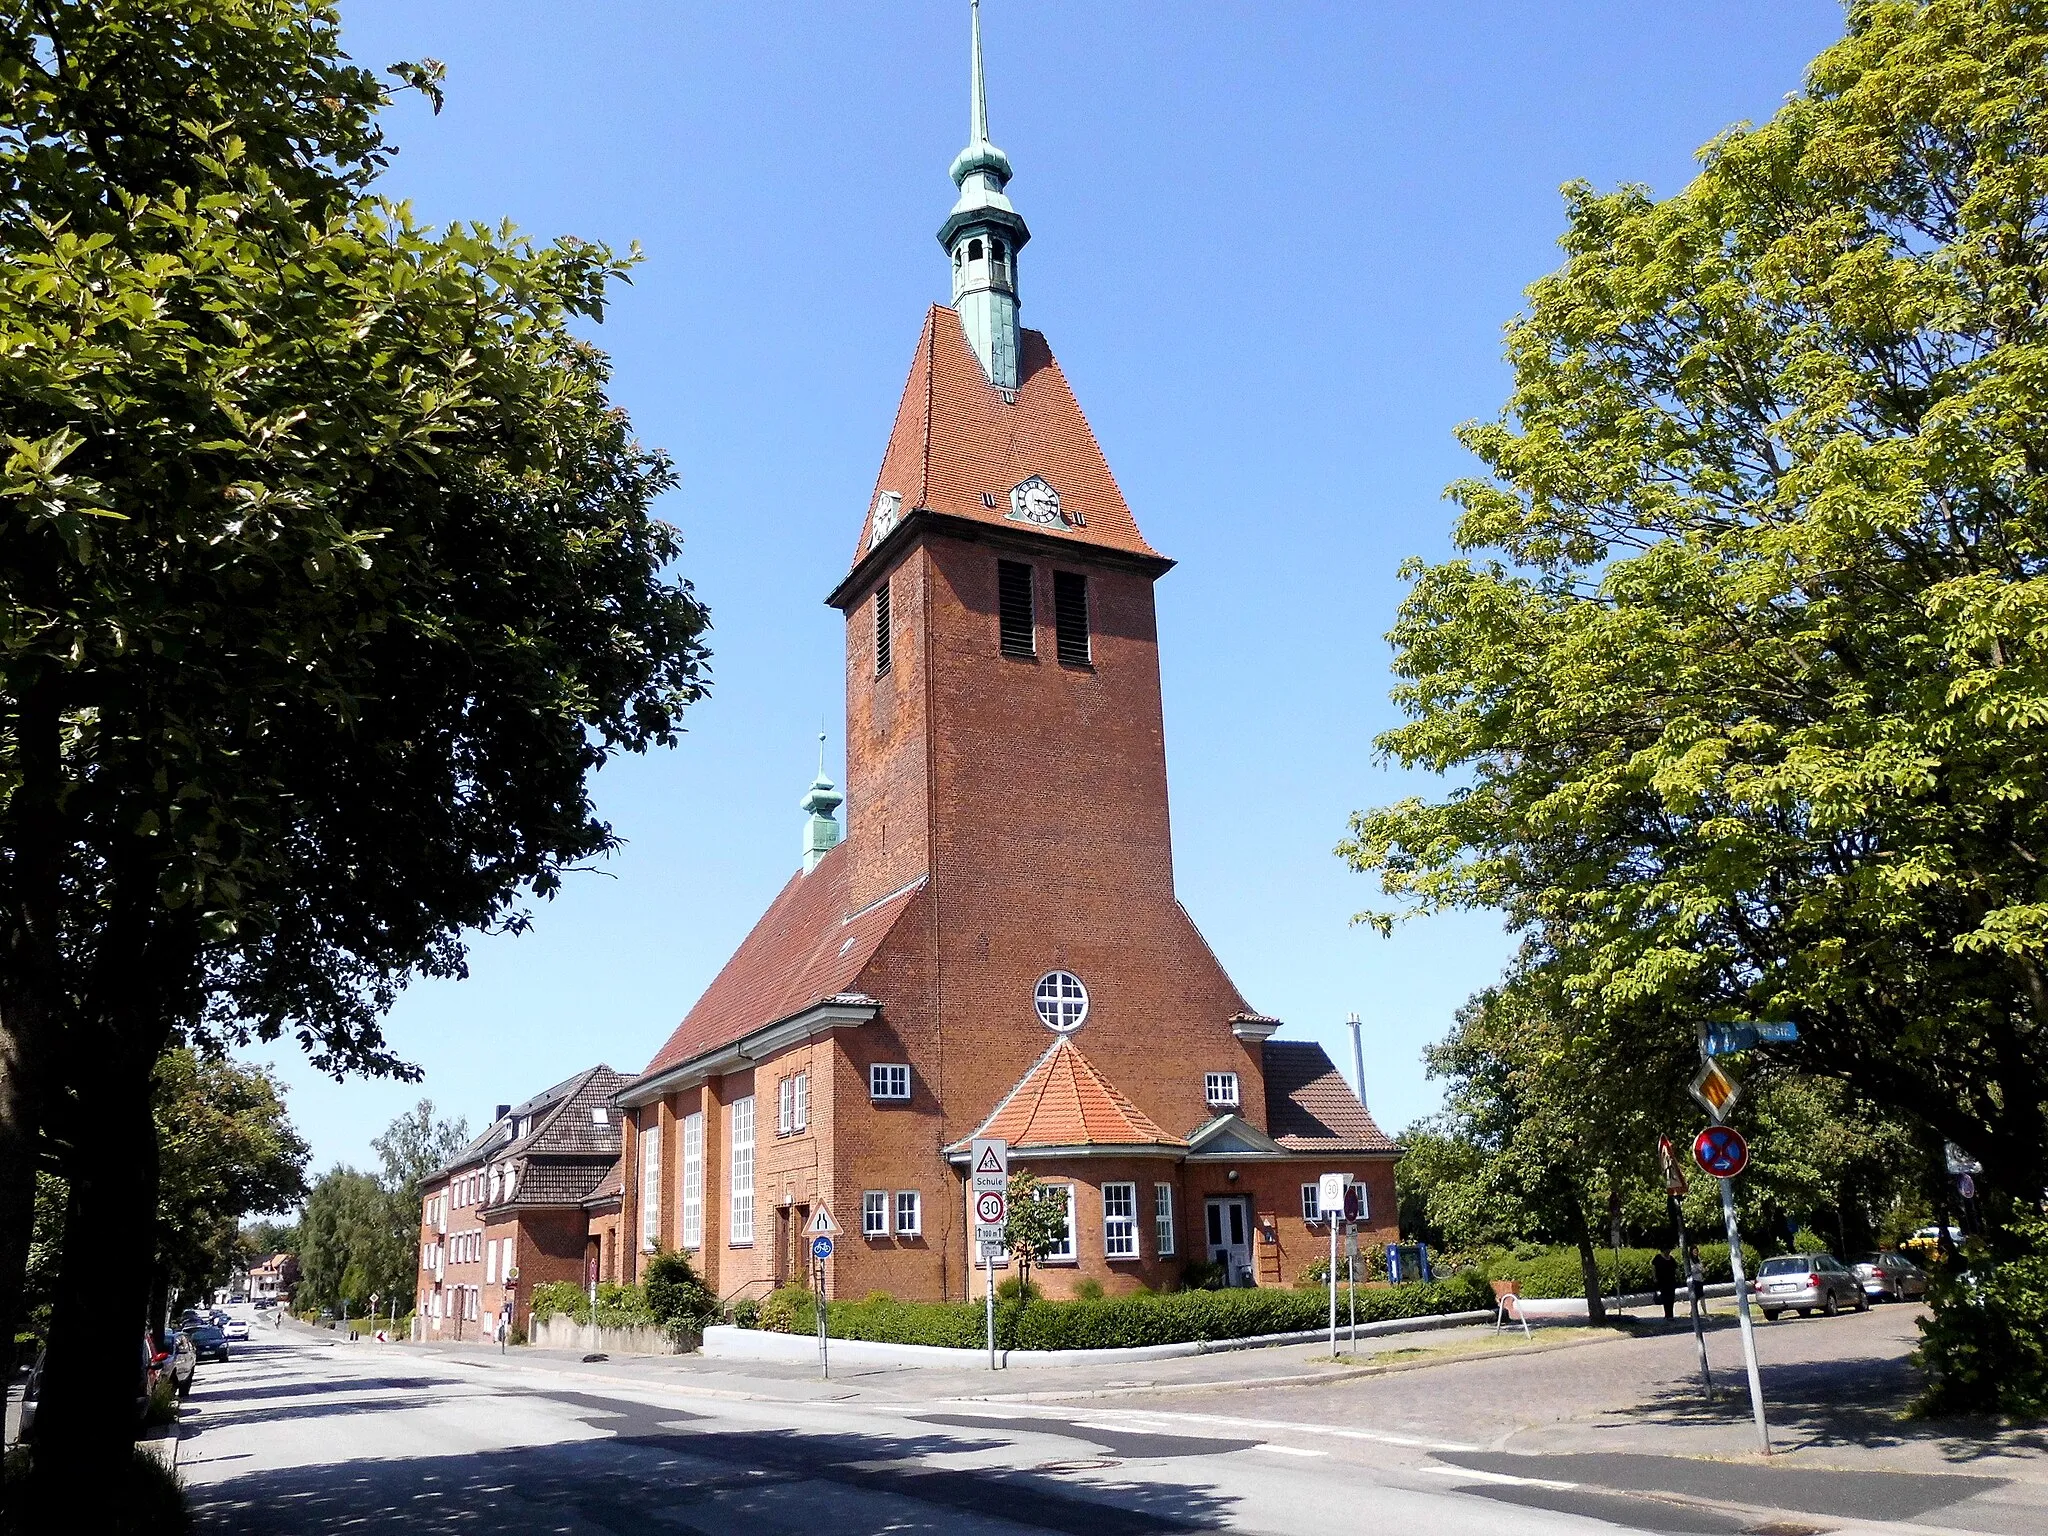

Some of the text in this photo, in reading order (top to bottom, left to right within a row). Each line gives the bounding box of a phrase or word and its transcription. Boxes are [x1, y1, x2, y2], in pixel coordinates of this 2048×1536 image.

[977, 1178, 1003, 1186] Schule
[1328, 1184, 1336, 1194] 30
[983, 1201, 998, 1215] 30
